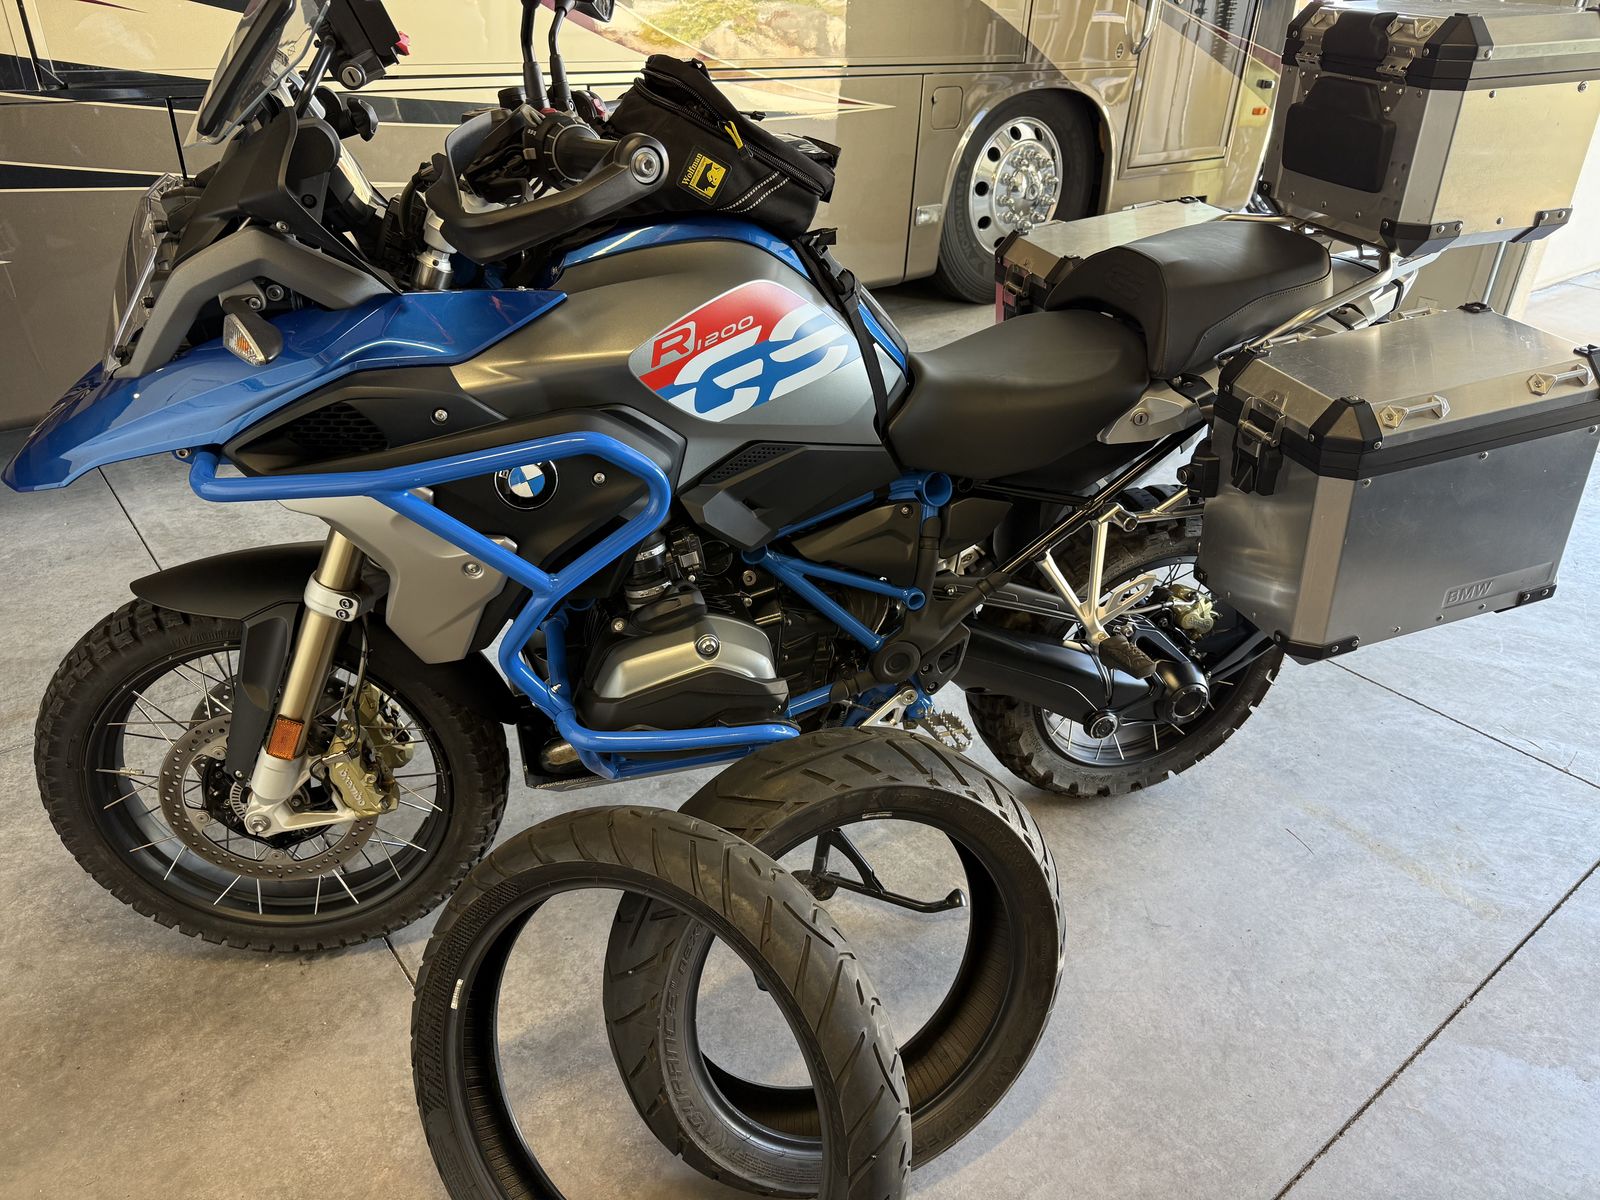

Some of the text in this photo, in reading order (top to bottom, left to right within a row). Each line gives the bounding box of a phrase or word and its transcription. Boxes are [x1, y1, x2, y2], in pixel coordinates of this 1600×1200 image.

[682, 153, 702, 185] Wolfman
[955, 170, 973, 258] YOKOHAMA
[1447, 581, 1494, 604] BMW
